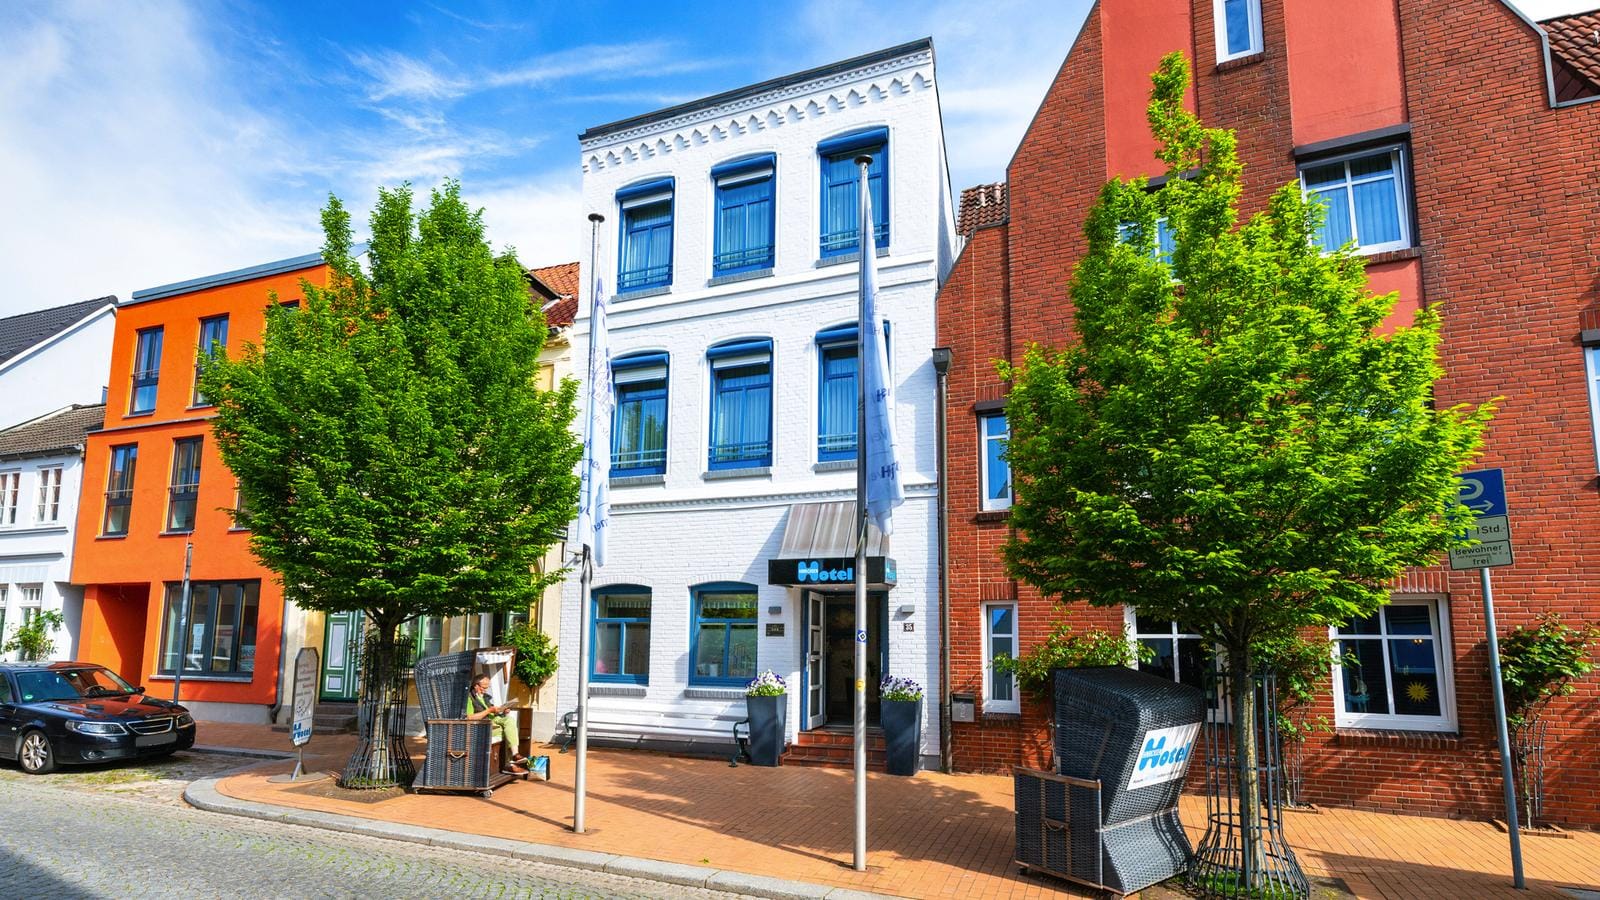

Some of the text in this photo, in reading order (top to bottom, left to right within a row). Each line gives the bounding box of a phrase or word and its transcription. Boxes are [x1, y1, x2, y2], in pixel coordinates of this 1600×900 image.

[1455, 544, 1503, 556] Bewohner
[1472, 556, 1490, 565] frei
[798, 561, 853, 581] Hotel
[1138, 736, 1191, 771] Hotel
